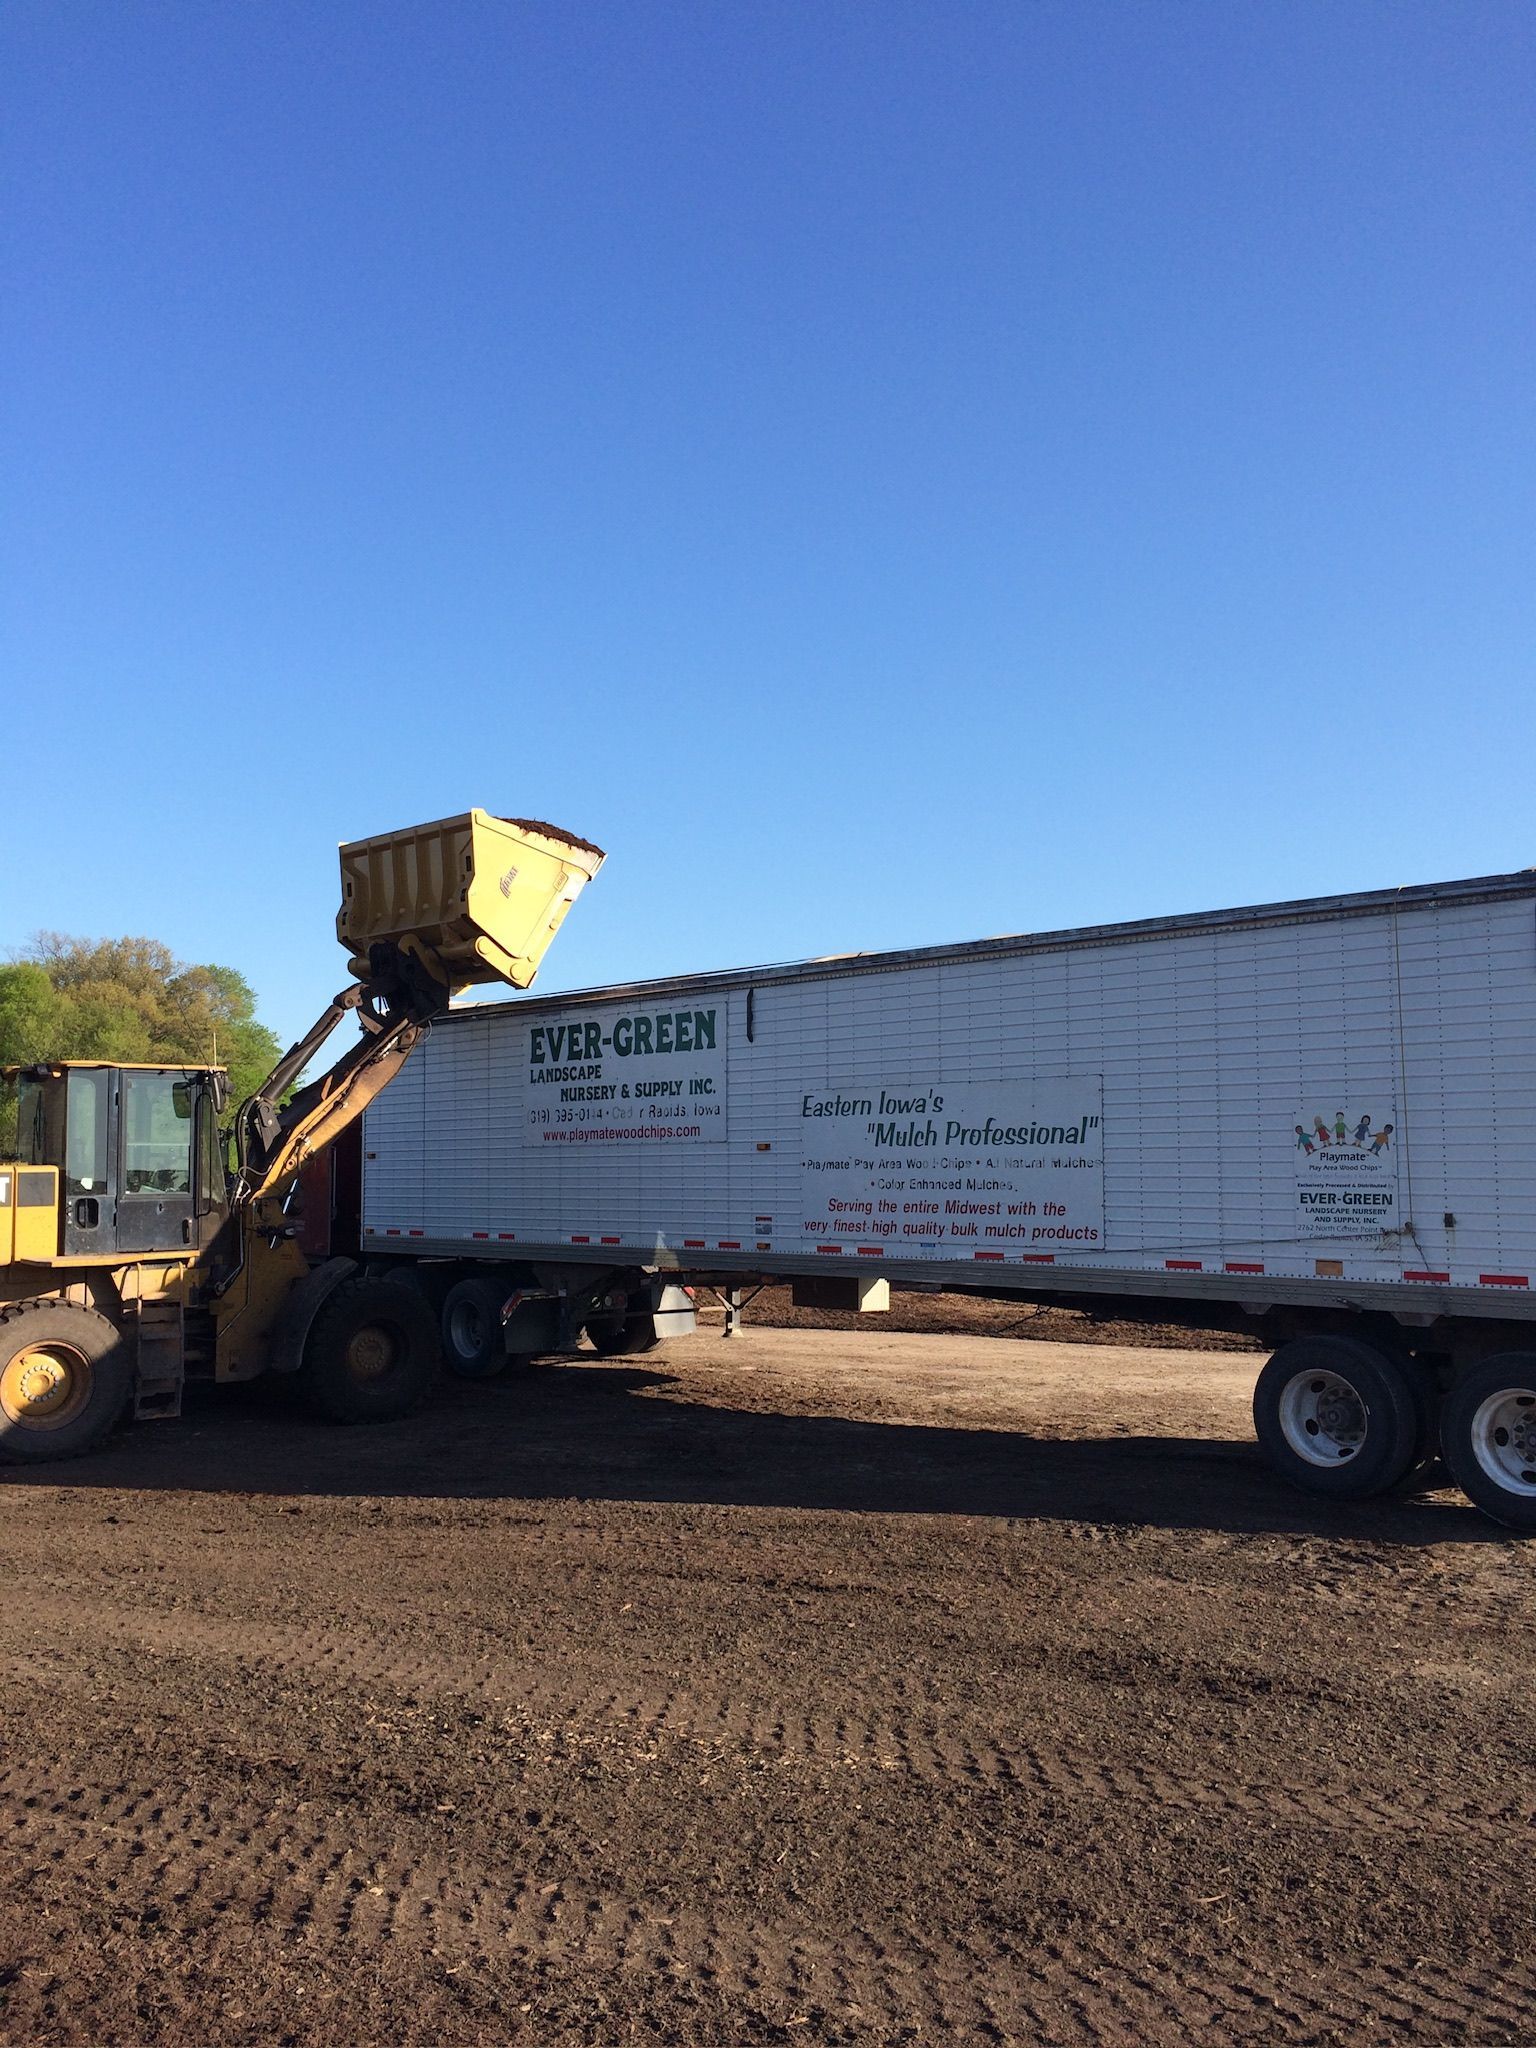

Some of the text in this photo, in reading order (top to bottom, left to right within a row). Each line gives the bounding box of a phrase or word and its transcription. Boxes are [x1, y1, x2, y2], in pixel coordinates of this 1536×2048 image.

[530, 1010, 716, 1064] EVER-GREEN
[530, 1065, 602, 1084] LANDSCAPE
[560, 1078, 716, 1102] NURSERY & SUPPLY INC.
[694, 1102, 721, 1116] Iowa
[802, 1089, 944, 1117] Eastern Iowa's
[543, 1124, 701, 1143] www.playmatewoodchips.com
[867, 1116, 1099, 1147] "Mulch Professional"
[807, 1159, 850, 1172] Playmate
[878, 1159, 902, 1169] Area
[1320, 1152, 1366, 1163] Playmate
[1360, 1164, 1378, 1172] Chips
[877, 1178, 906, 1191] Color
[909, 1178, 962, 1190] Enhanced
[1300, 1192, 1393, 1205] EVER-GREEN
[828, 1199, 1067, 1217] Serving the entire Midwest with the
[804, 1219, 1099, 1241] very finest high quality bulk mulch products
[1315, 1224, 1335, 1232] North
[1360, 1225, 1378, 1233] Point
